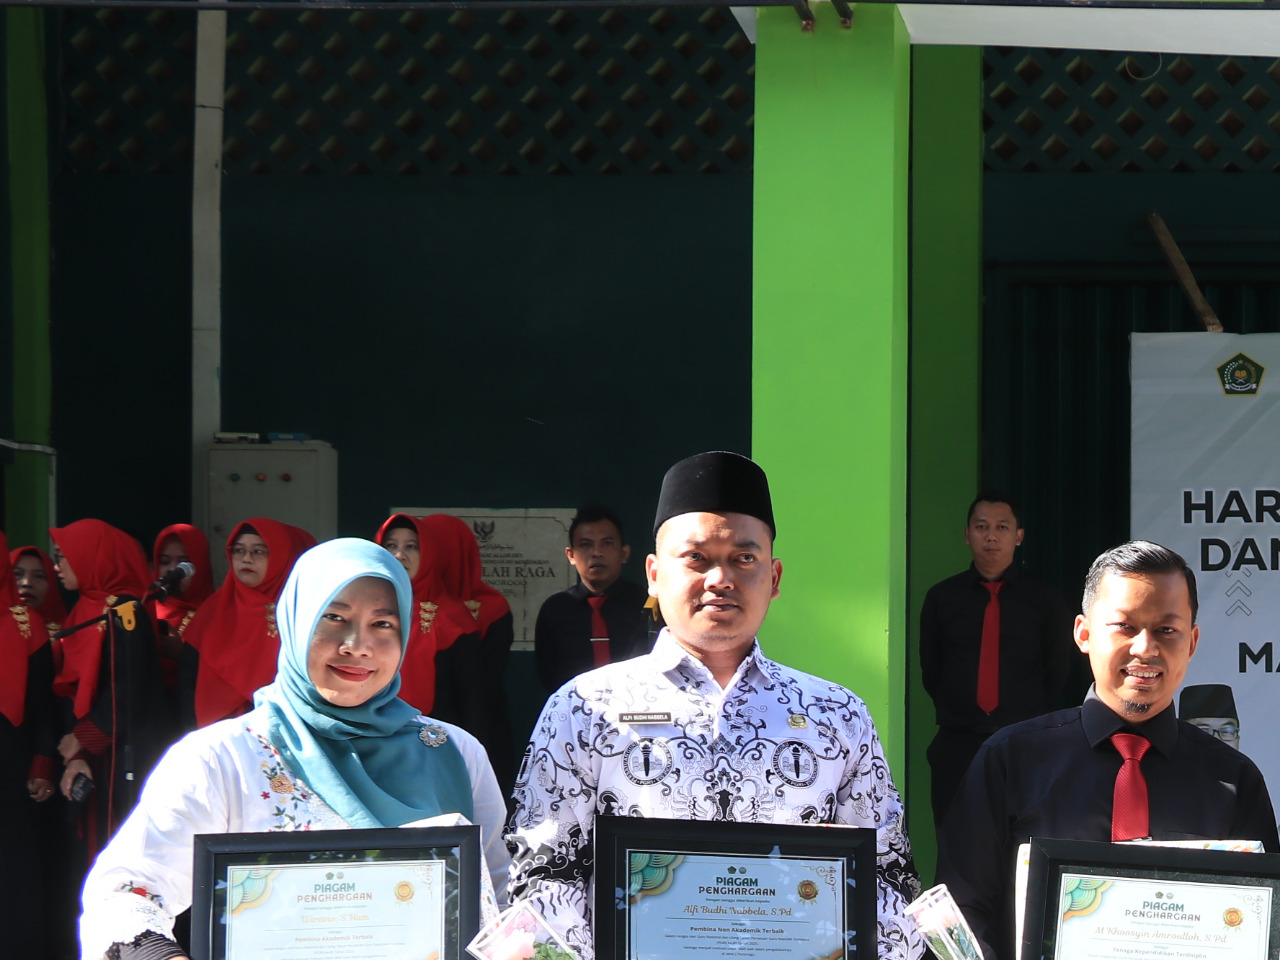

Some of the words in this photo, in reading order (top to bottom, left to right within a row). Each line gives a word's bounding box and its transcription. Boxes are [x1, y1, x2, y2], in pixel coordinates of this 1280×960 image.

[482, 566, 510, 578] LAH
[515, 566, 556, 578] RAGA
[716, 876, 758, 887] PIAGAM
[314, 882, 355, 893] PIAGAM
[698, 886, 776, 896] PENGHARGAAN
[297, 893, 373, 903] PENGHARGAAN
[683, 904, 699, 916] Alfi
[700, 905, 728, 914] Budhi
[770, 907, 793, 916] S.Pd
[1143, 901, 1185, 912] PIAGAM
[1125, 909, 1201, 922] PENGHARGAAN
